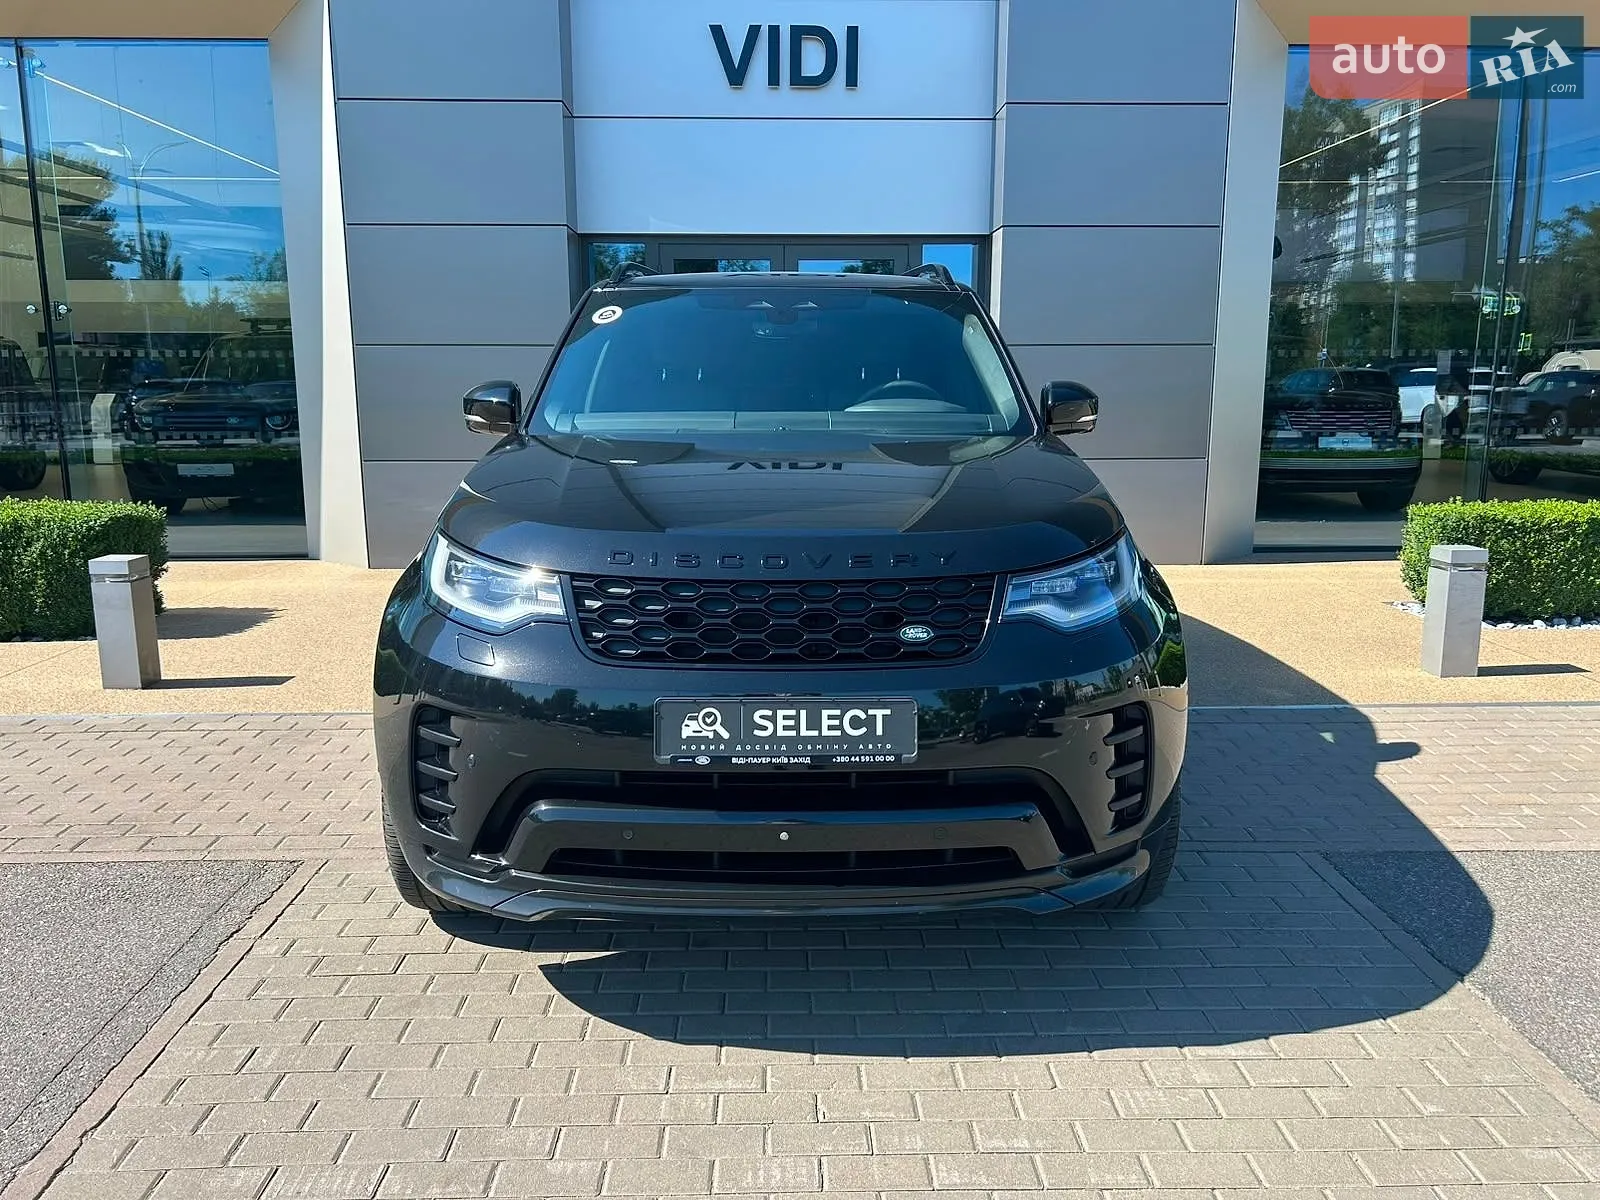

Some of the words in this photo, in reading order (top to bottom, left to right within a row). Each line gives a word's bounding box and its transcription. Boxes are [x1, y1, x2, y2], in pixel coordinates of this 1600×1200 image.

[708, 24, 860, 88] VIDI
[607, 550, 957, 570] DISCOVERY
[752, 708, 892, 737] SELECT
[681, 743, 725, 751] НОВИЙ
[797, 743, 848, 751] ОБМІНУ
[771, 756, 788, 764] КИЇВ
[789, 756, 811, 764] ЗАХІД
